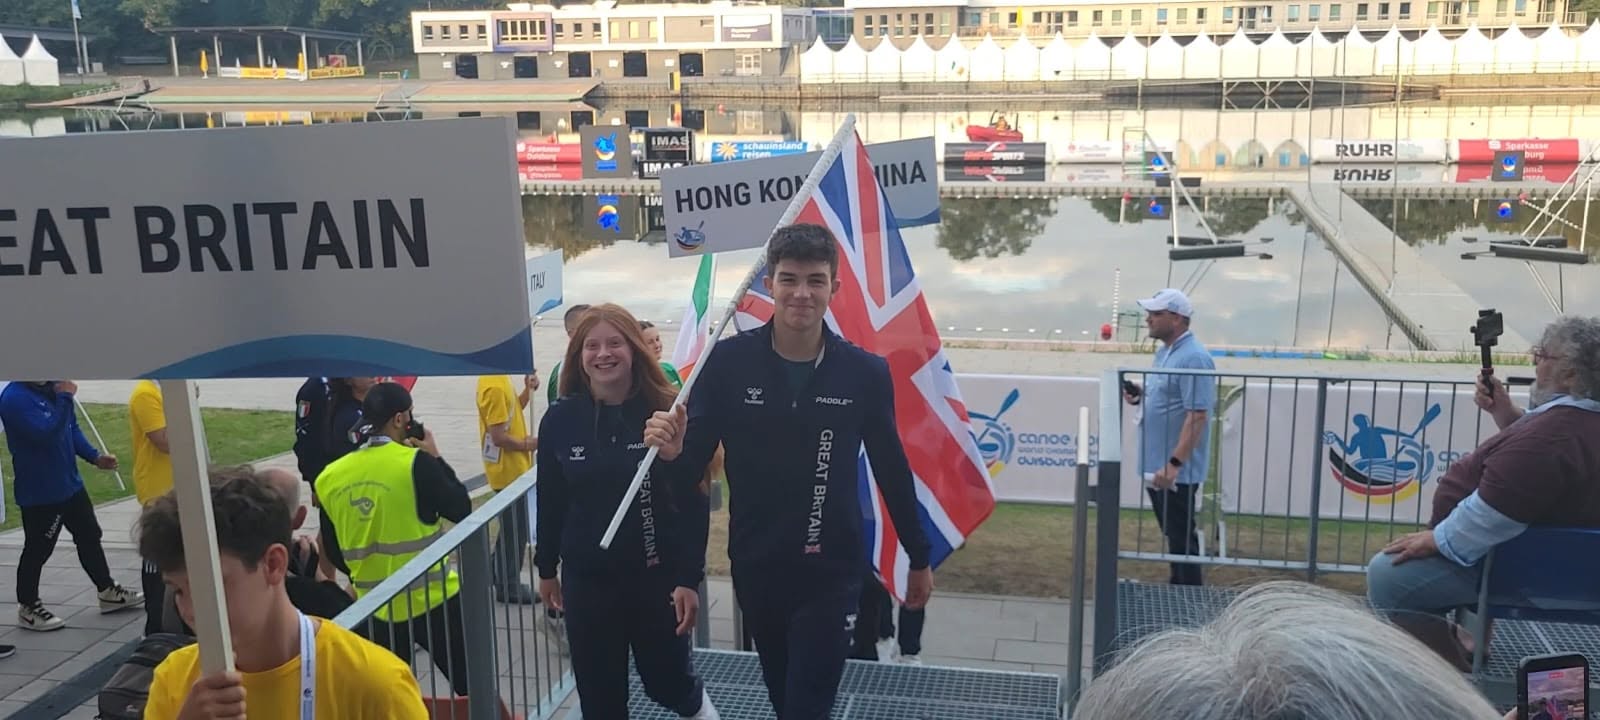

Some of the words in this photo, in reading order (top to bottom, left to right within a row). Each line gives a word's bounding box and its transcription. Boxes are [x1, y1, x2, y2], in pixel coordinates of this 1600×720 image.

[652, 136, 689, 146] IMAS
[742, 142, 804, 151] schauinsland
[1505, 142, 1549, 151] Sparkasse
[1335, 143, 1393, 157] RUHR
[1524, 151, 1545, 160] burg
[675, 182, 750, 213] HONG
[874, 160, 926, 187] INA
[134, 198, 430, 273] BRITAIN
[530, 271, 545, 292] ITALY
[1018, 432, 1071, 445] canoe
[815, 429, 834, 481] GREAT
[807, 485, 826, 543] BRITAIN
[641, 507, 658, 557] BRITAIN
